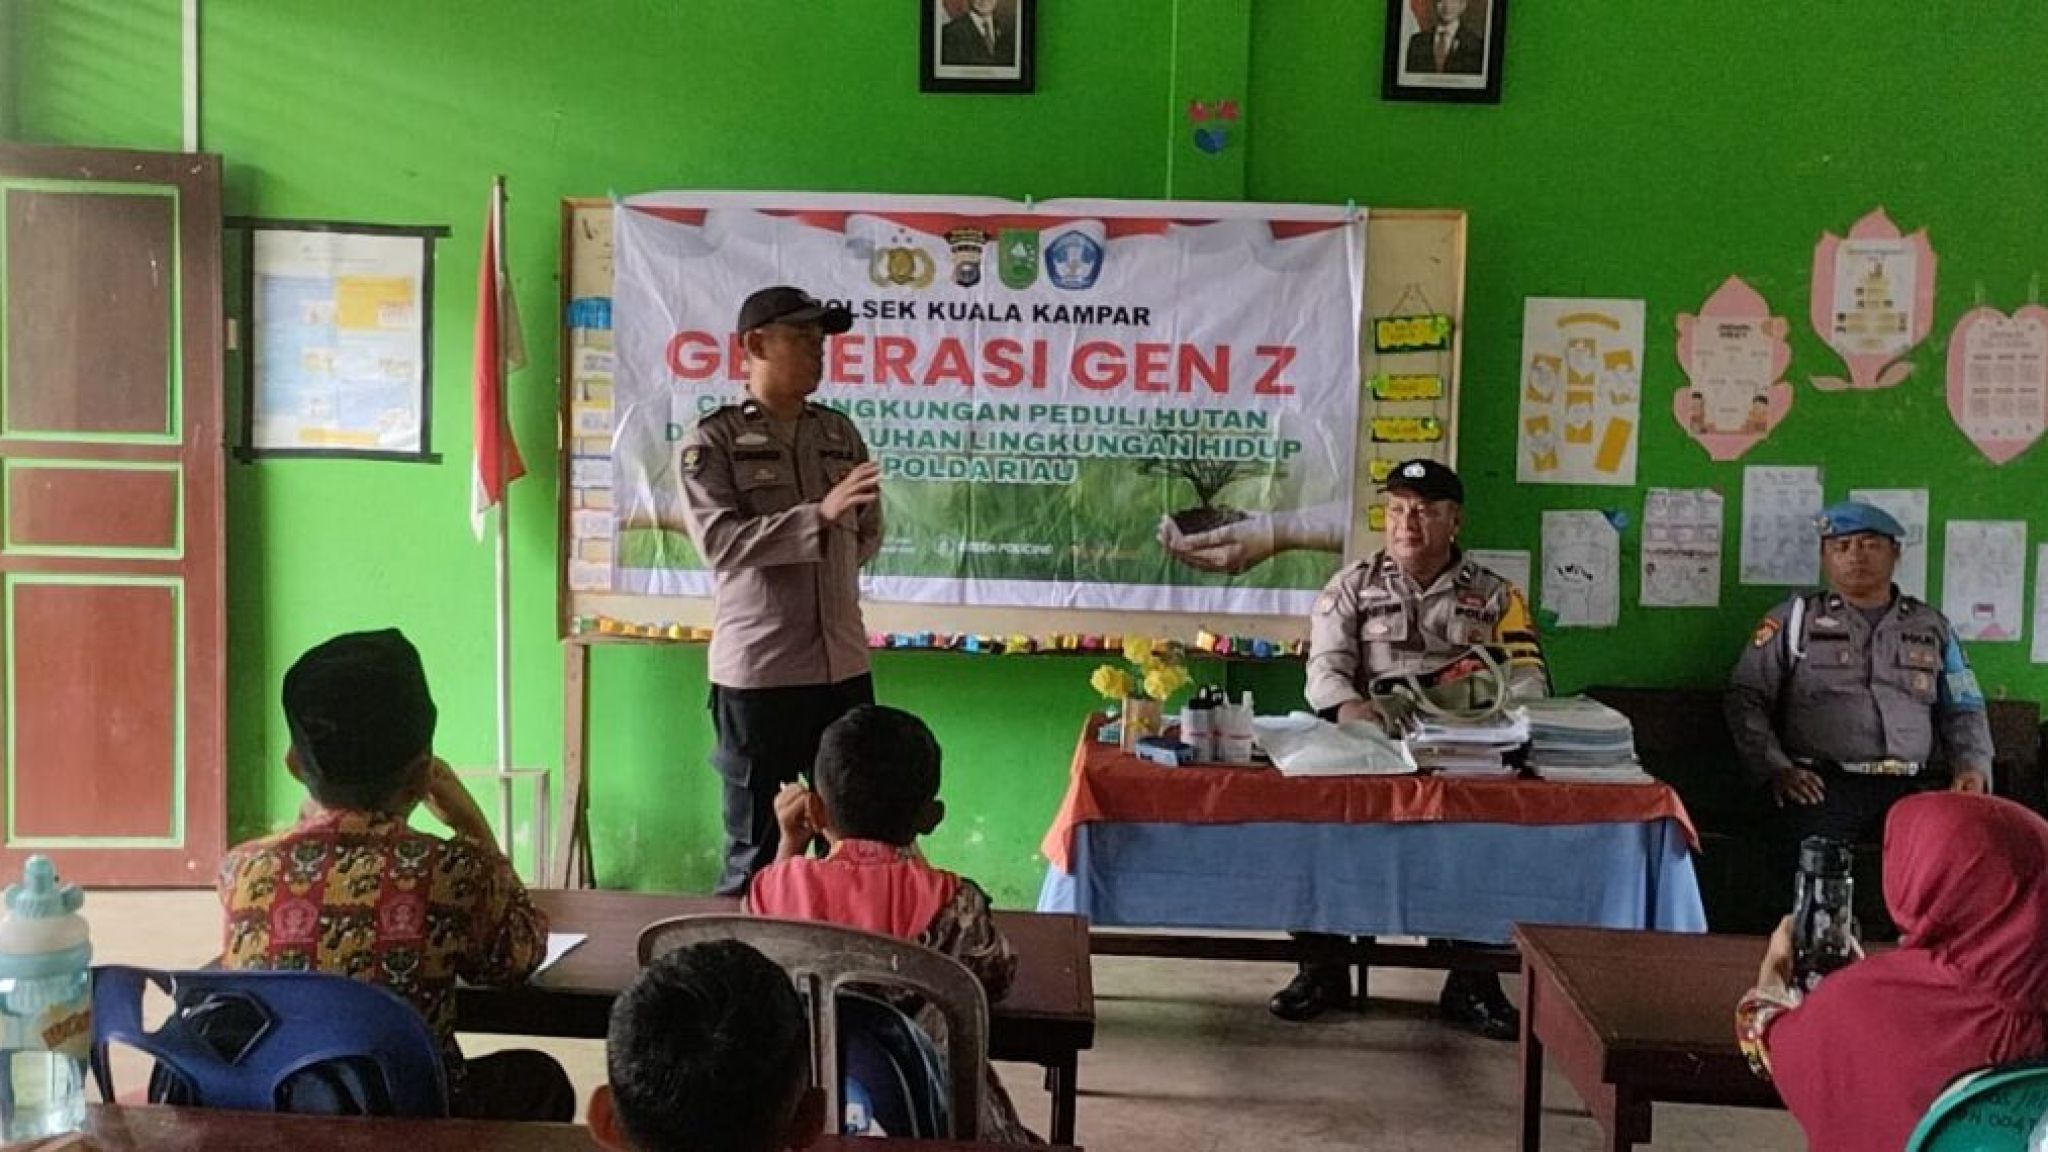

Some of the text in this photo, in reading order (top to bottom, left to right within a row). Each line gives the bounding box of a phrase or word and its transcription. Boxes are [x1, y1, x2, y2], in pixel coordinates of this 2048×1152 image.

[816, 299, 1150, 326] OLSEK KUALA KAMPAR
[666, 331, 1297, 395] GEERASI GEN Z
[1029, 403, 1145, 426] PEDULI
[1155, 407, 1267, 430] HUTAN
[970, 430, 1190, 456] LINGKUNGAN
[1200, 437, 1302, 460] HIDUP
[883, 456, 991, 480] POLDA
[998, 459, 1075, 483] RIAU
